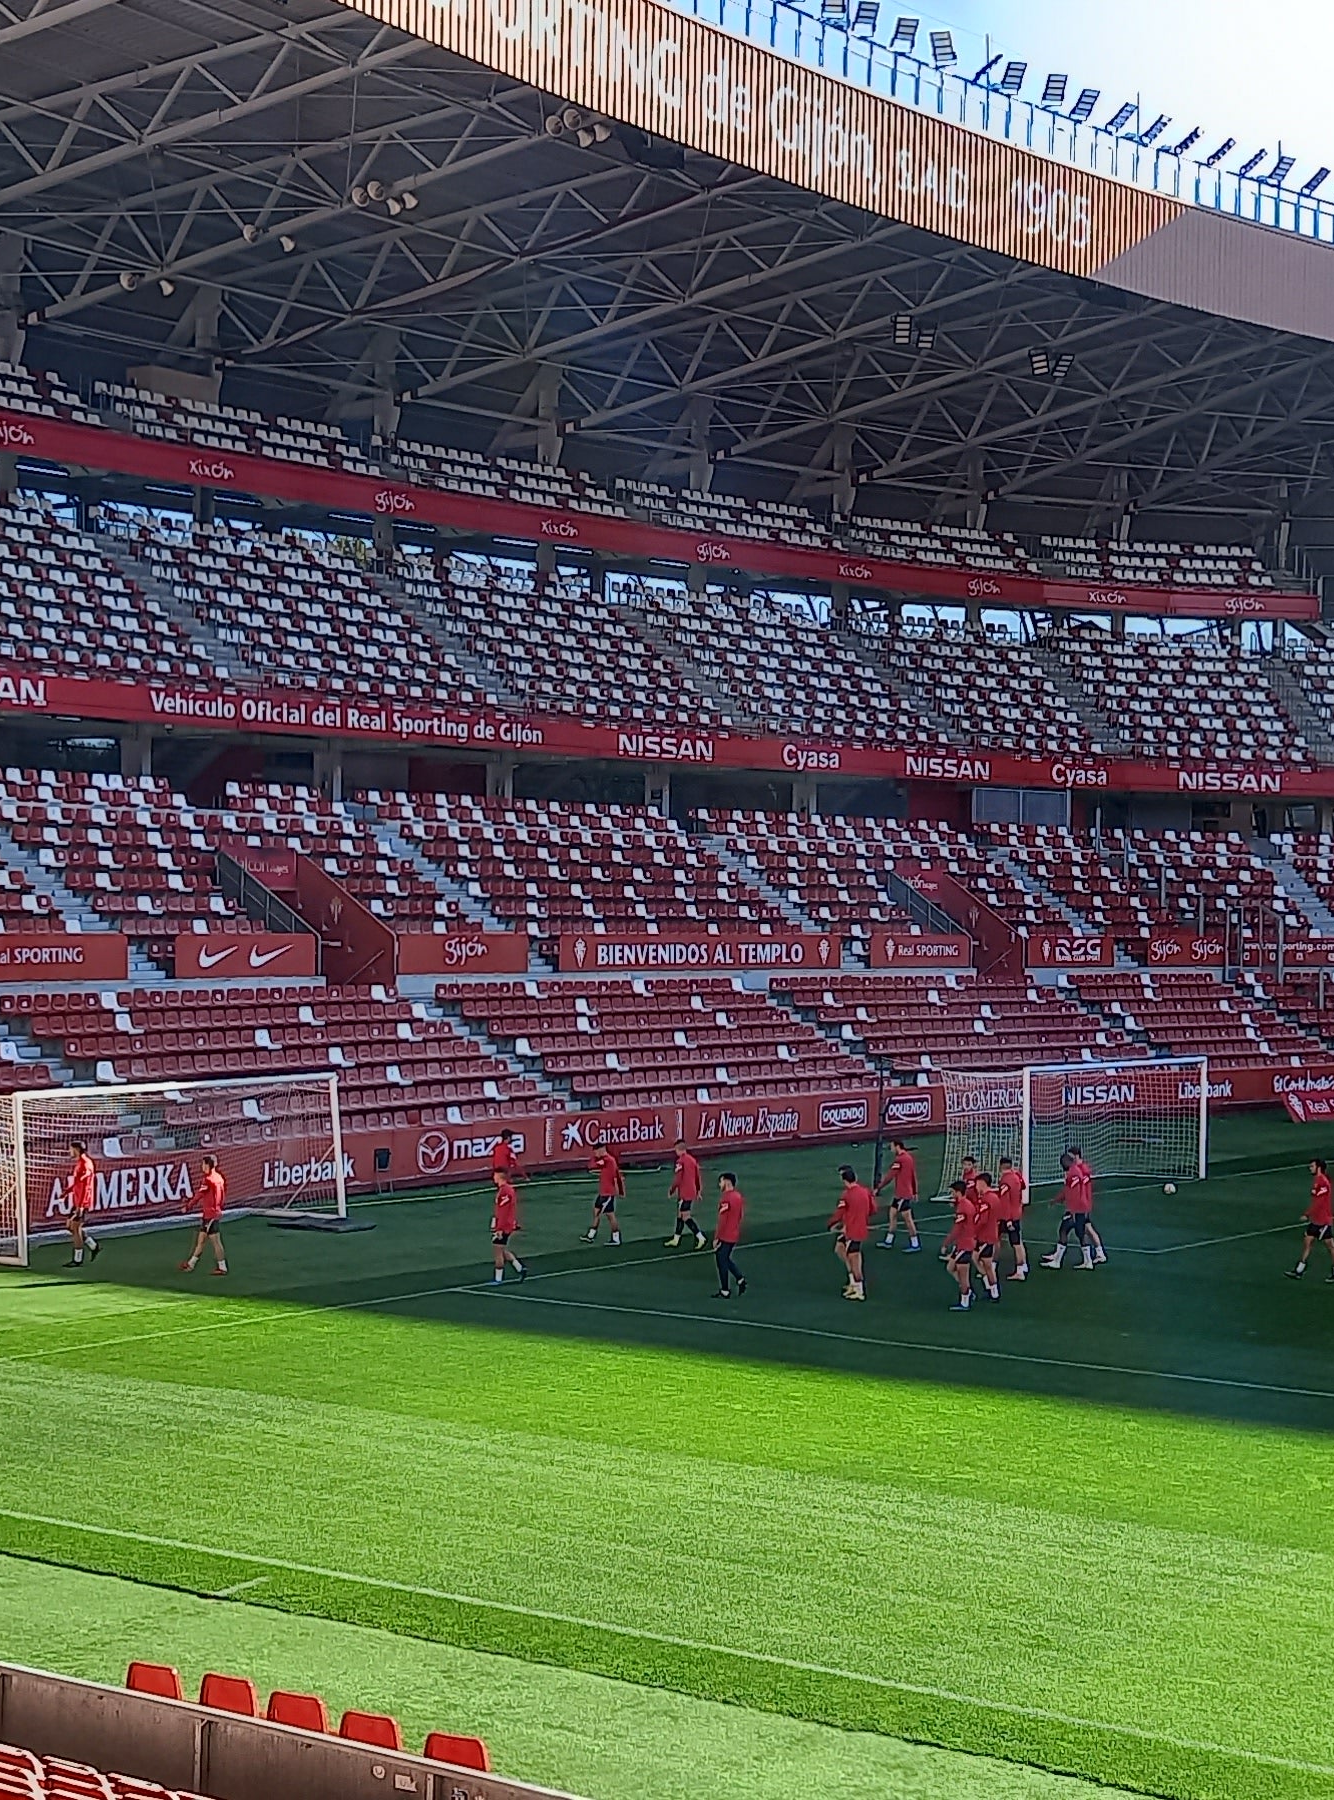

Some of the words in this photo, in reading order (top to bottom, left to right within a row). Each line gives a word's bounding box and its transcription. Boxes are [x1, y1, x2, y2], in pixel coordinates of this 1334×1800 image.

[430, 0, 682, 110] ORTING
[703, 57, 752, 133] de
[1010, 172, 1091, 250] 1905
[375, 491, 415, 514] gijón
[150, 689, 235, 720] Vehículo
[242, 699, 307, 726] Oficial
[311, 705, 341, 728] del
[347, 709, 387, 732] Real
[392, 711, 468, 742] Sporting
[473, 717, 496, 741] de
[499, 721, 544, 750] Gijón
[618, 733, 714, 762] NISSAN
[782, 744, 841, 771] Cyasa
[905, 756, 990, 781] NISSAN
[1051, 763, 1109, 788] Cyasa
[1178, 770, 1281, 793] NISSAN
[14, 945, 84, 965] SPORTING
[445, 937, 488, 966] gijón
[597, 943, 709, 966] BIENVENIDOS
[713, 943, 734, 964] AL
[737, 942, 803, 964] TEMPLO
[897, 944, 915, 957] Real
[917, 944, 959, 958] SPORTING
[1151, 940, 1182, 962] gijón
[1062, 1084, 1135, 1105] NISSAN
[1178, 1081, 1232, 1099] Libebank
[823, 1106, 864, 1122] OQUENDO
[888, 1101, 928, 1117] OQUENDO
[585, 1117, 664, 1146] CaixaBank
[698, 1112, 715, 1140] La
[718, 1109, 754, 1138] Nueva
[755, 1106, 798, 1137] España
[453, 1133, 524, 1160] maza
[264, 1155, 355, 1189] Liberbak
[46, 1162, 193, 1218] AMERKA
